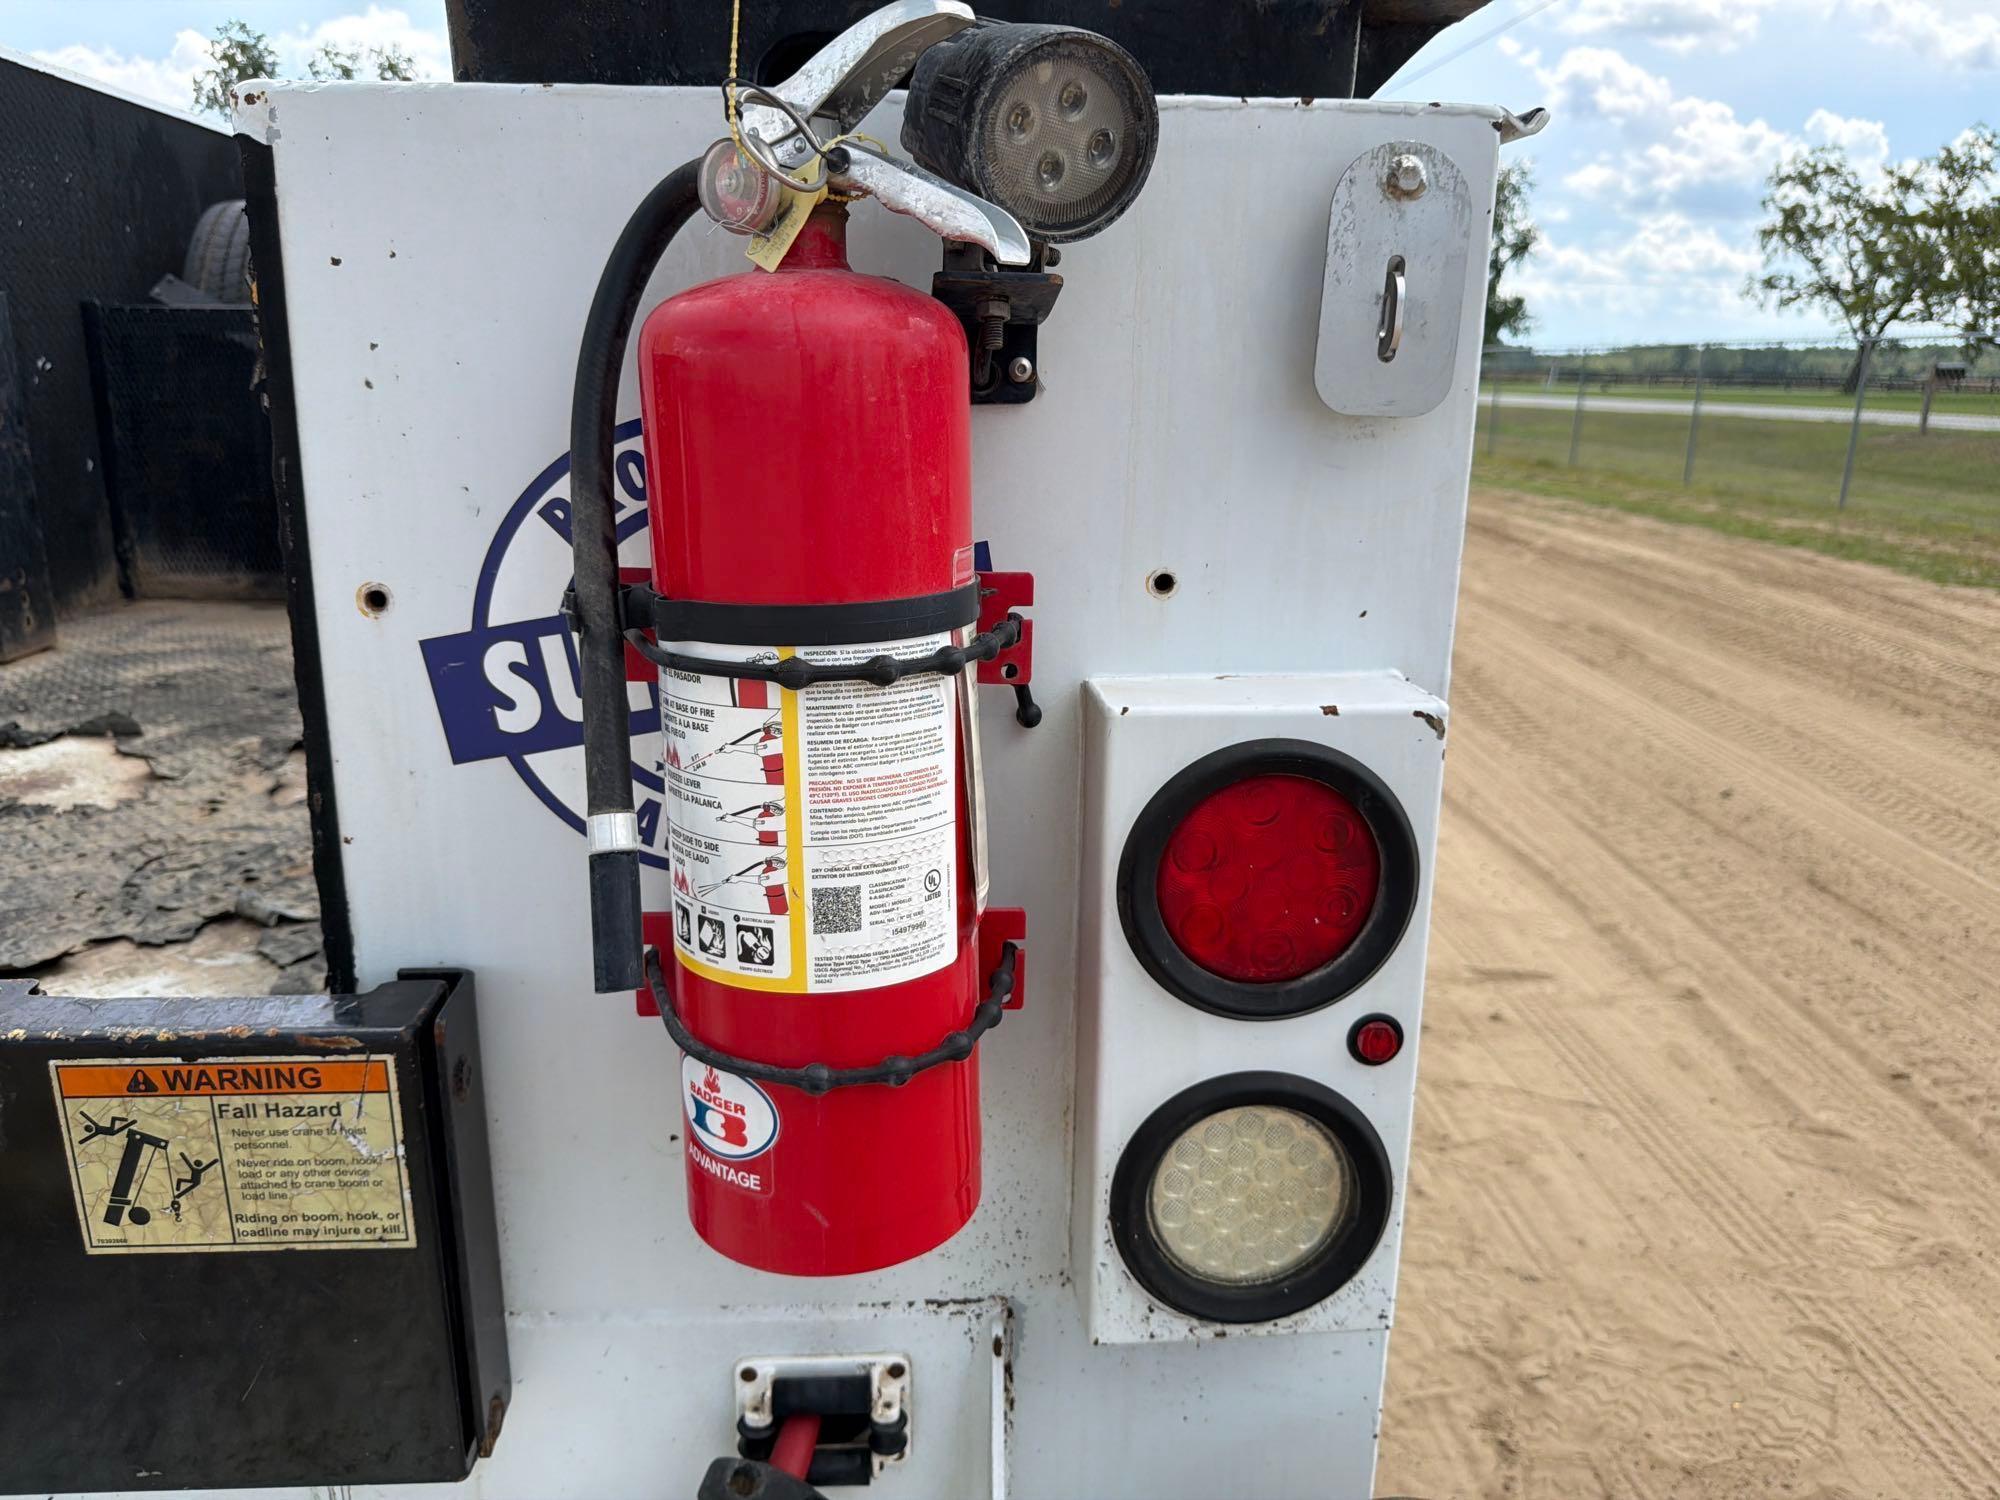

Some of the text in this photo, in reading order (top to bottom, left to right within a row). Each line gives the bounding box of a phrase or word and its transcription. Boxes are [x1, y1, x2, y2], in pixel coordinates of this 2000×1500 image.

[674, 670, 701, 684] PASADOR
[676, 702, 689, 714] BASE
[689, 706, 698, 715] OF
[700, 708, 715, 718] FIRE
[671, 727, 686, 739] FUEGO
[683, 719, 691, 729] LA
[692, 721, 709, 733] BASE
[683, 777, 701, 790] LEVER
[683, 791, 690, 802] LA
[691, 793, 723, 810] PALANCA
[682, 832, 693, 846] SIDE
[694, 838, 702, 848] TO
[704, 840, 720, 852] SIDE
[685, 849, 692, 859] DE
[692, 851, 710, 865] LADO
[928, 874, 937, 887] UL
[924, 890, 941, 902] LISTED
[162, 1067, 322, 1092] WARNING
[690, 1080, 746, 1117] BADGER
[218, 1101, 342, 1119] Fall Hazard
[232, 1125, 367, 1138] Never use crane to hoist
[234, 1140, 292, 1152] personnel.
[236, 1158, 271, 1169] Never
[273, 1157, 294, 1168] ride
[298, 1158, 311, 1167] on
[314, 1157, 349, 1168] boom,
[689, 1141, 762, 1191] ADVANTAGE
[239, 1167, 370, 1181] load or any other device
[240, 1178, 383, 1190] attached to crane boom or
[241, 1191, 265, 1201] load
[235, 1211, 400, 1225] Riding on boom, hook, or
[237, 1224, 405, 1240] loadline may injure or kill.
